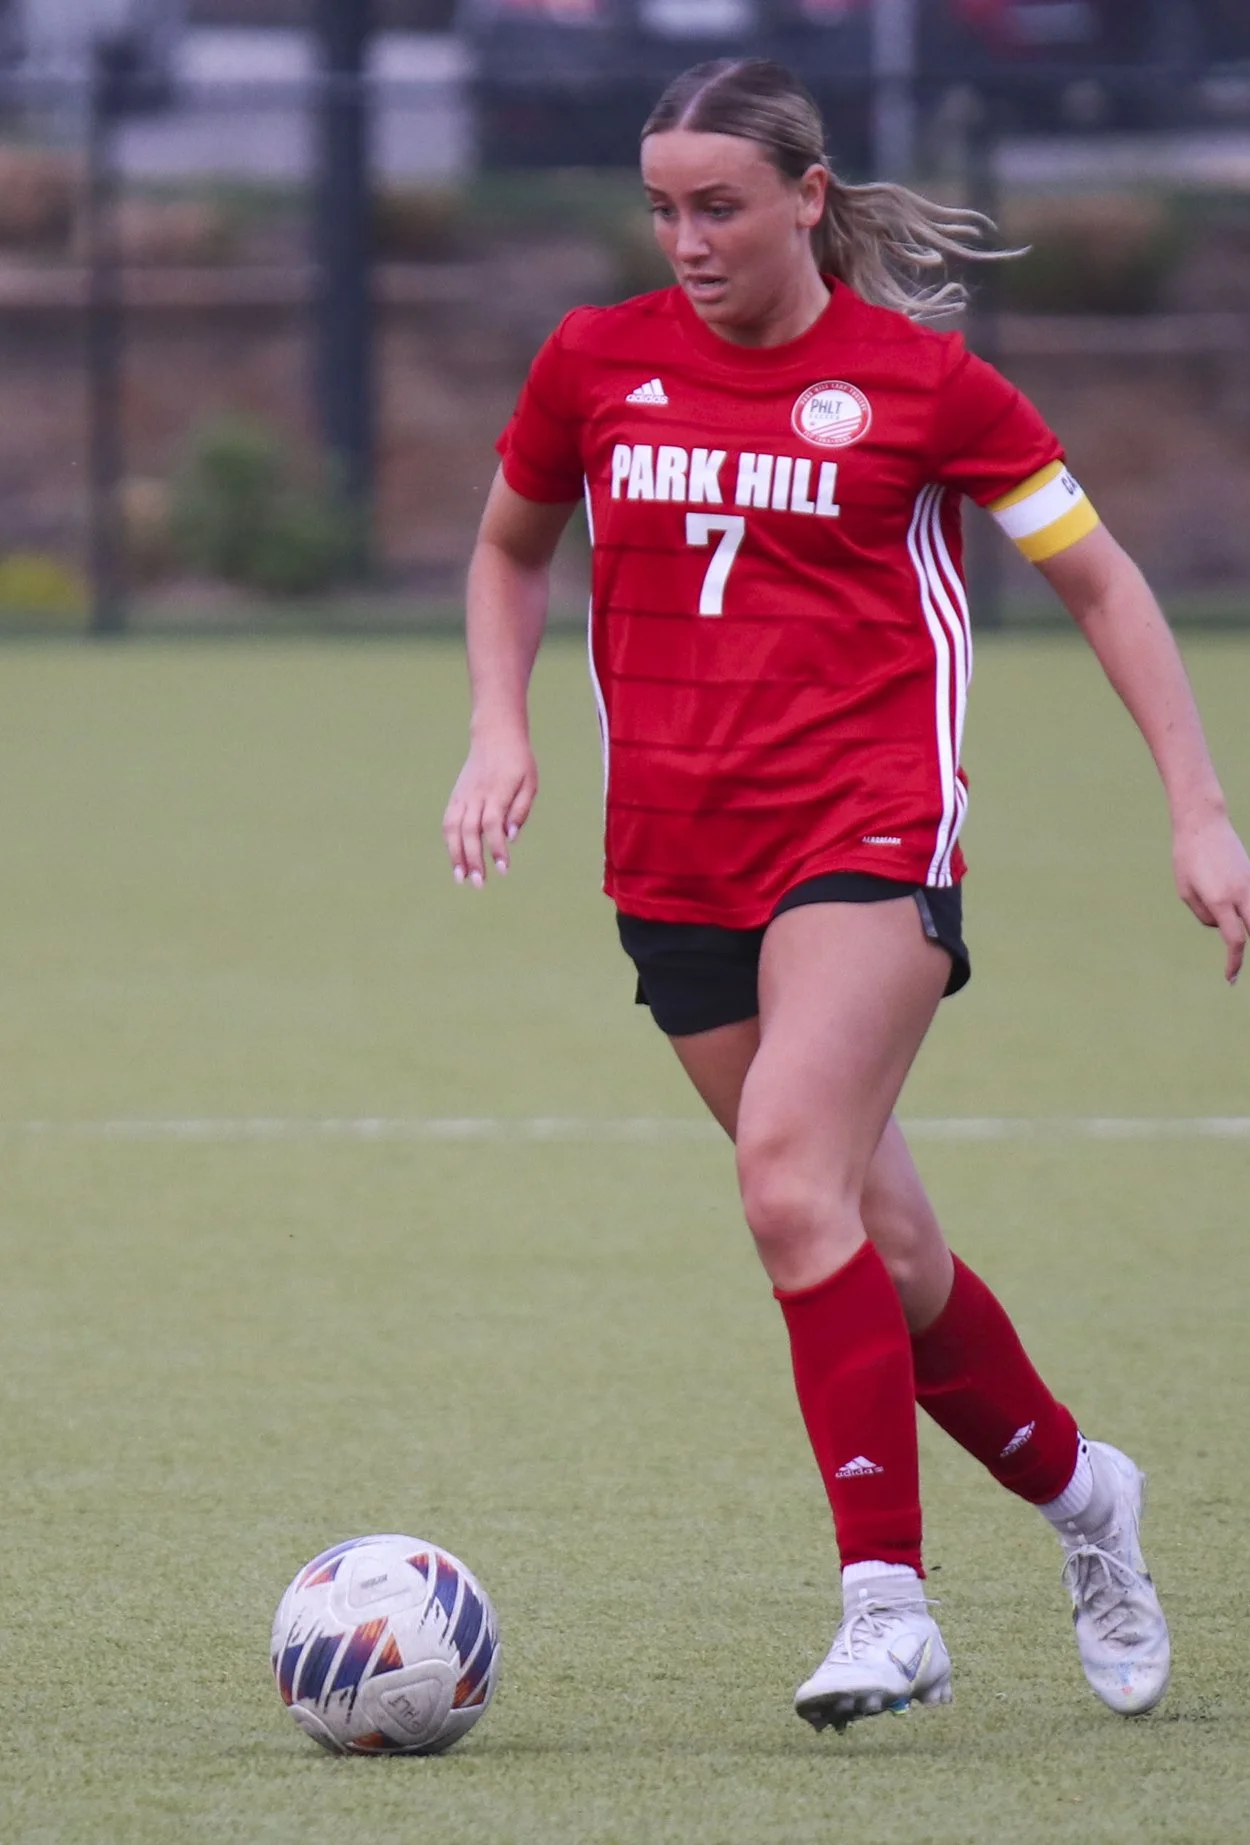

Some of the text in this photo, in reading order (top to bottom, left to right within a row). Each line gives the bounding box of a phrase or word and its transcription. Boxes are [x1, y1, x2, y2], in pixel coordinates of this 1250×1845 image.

[625, 393, 669, 405] adidas
[810, 398, 843, 414] PHLT
[611, 443, 840, 517] PARK HILL
[685, 511, 746, 618] 7
[835, 1466, 884, 1479] adidas
